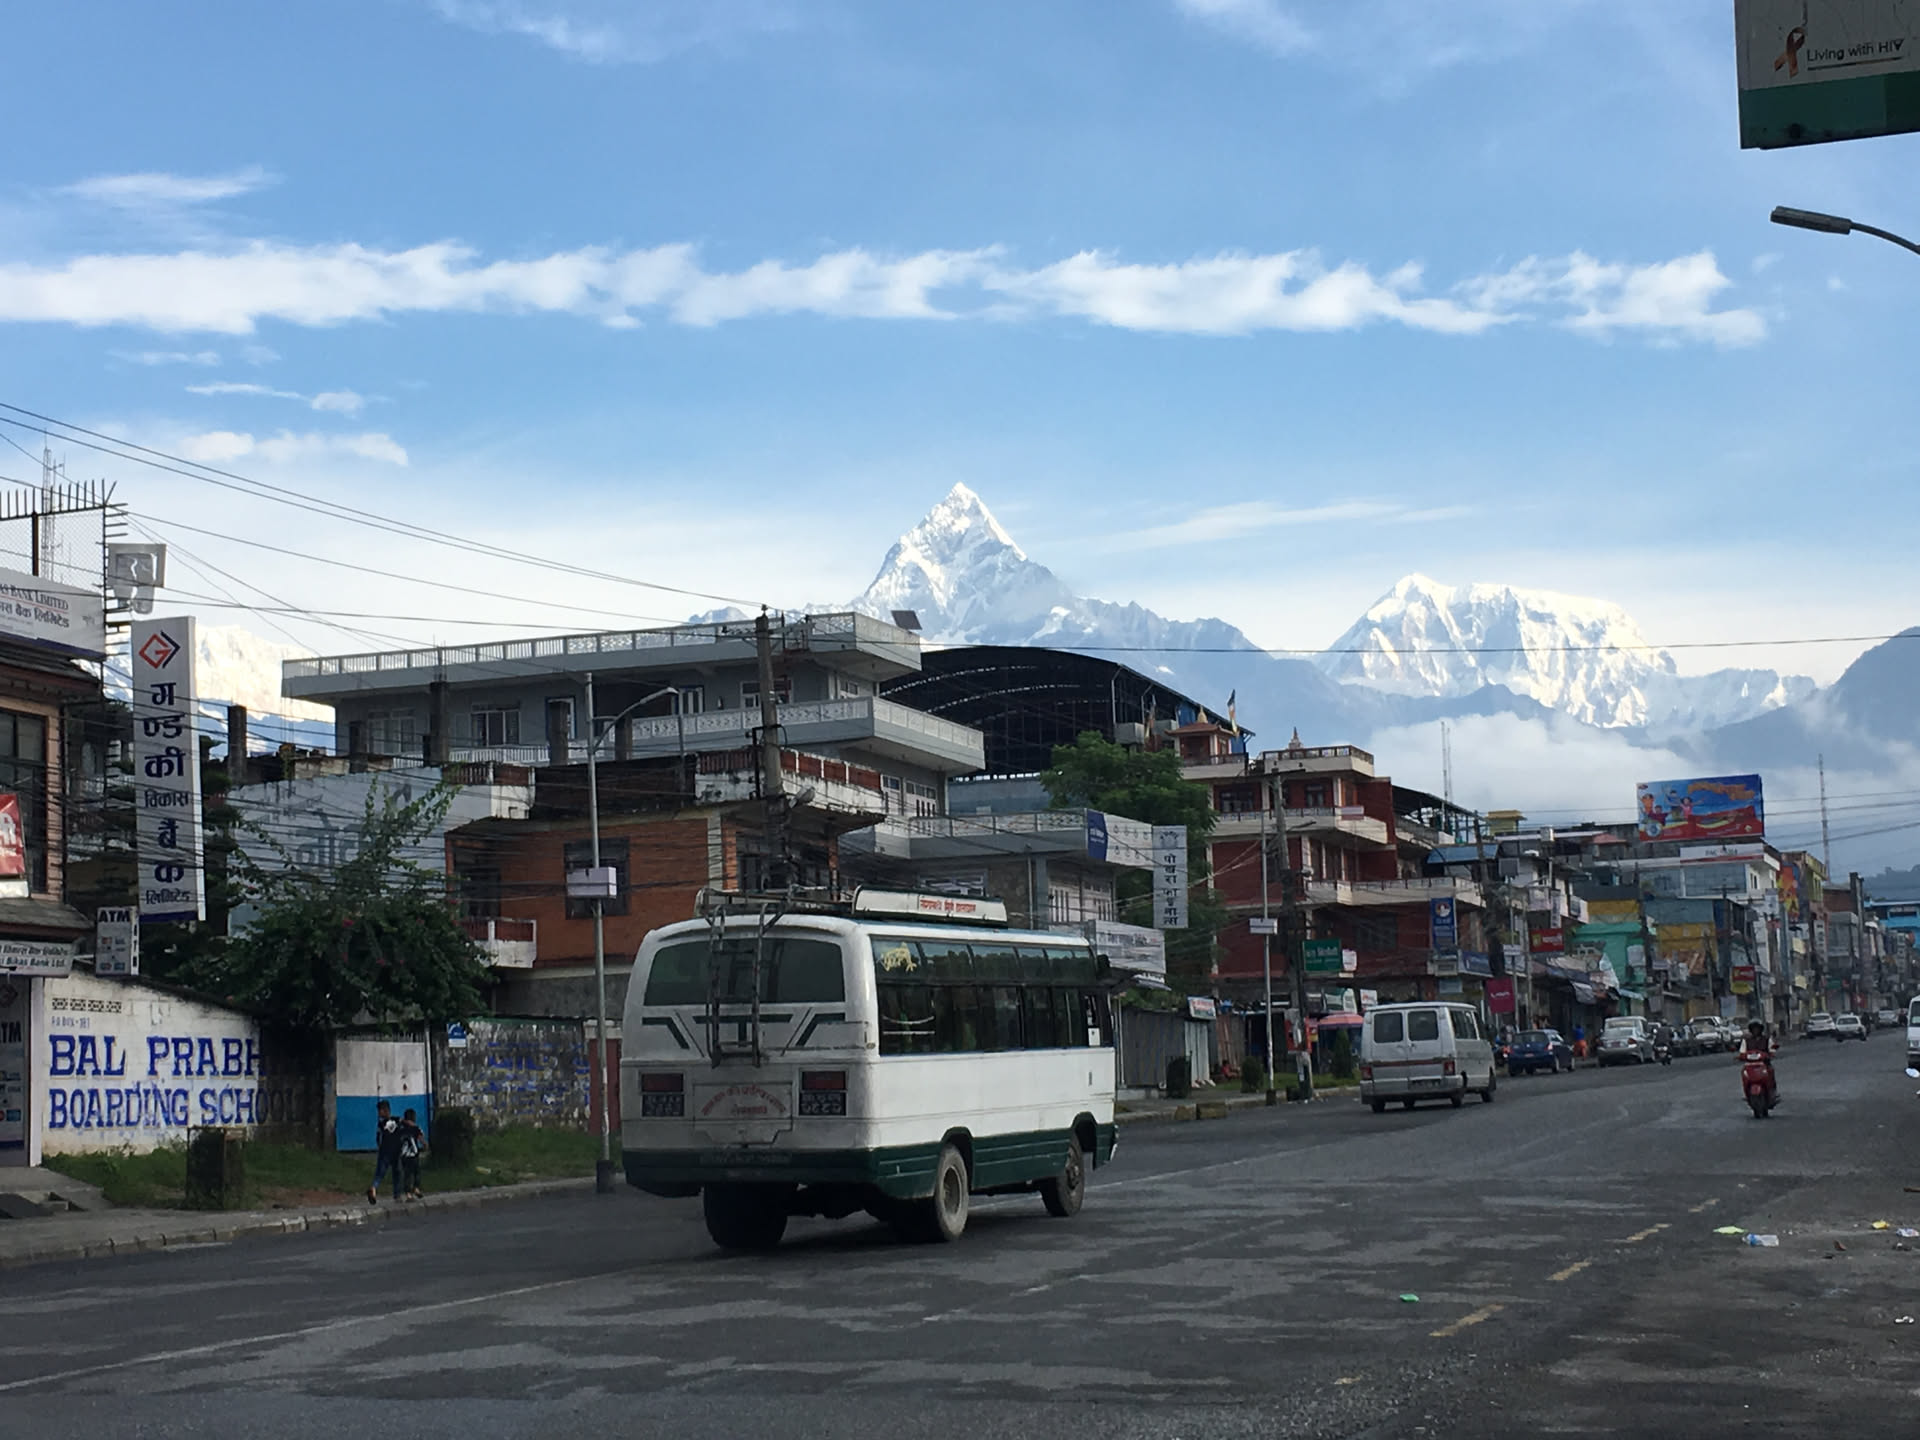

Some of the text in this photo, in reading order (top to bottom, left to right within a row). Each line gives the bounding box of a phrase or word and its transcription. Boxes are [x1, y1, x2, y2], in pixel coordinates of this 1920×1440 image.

[1806, 38, 1904, 62] Living with HIV
[35, 590, 69, 611] LIMITED
[98, 909, 131, 923] ATM
[49, 1034, 126, 1077] BAL
[49, 1084, 190, 1129] BOARDING
